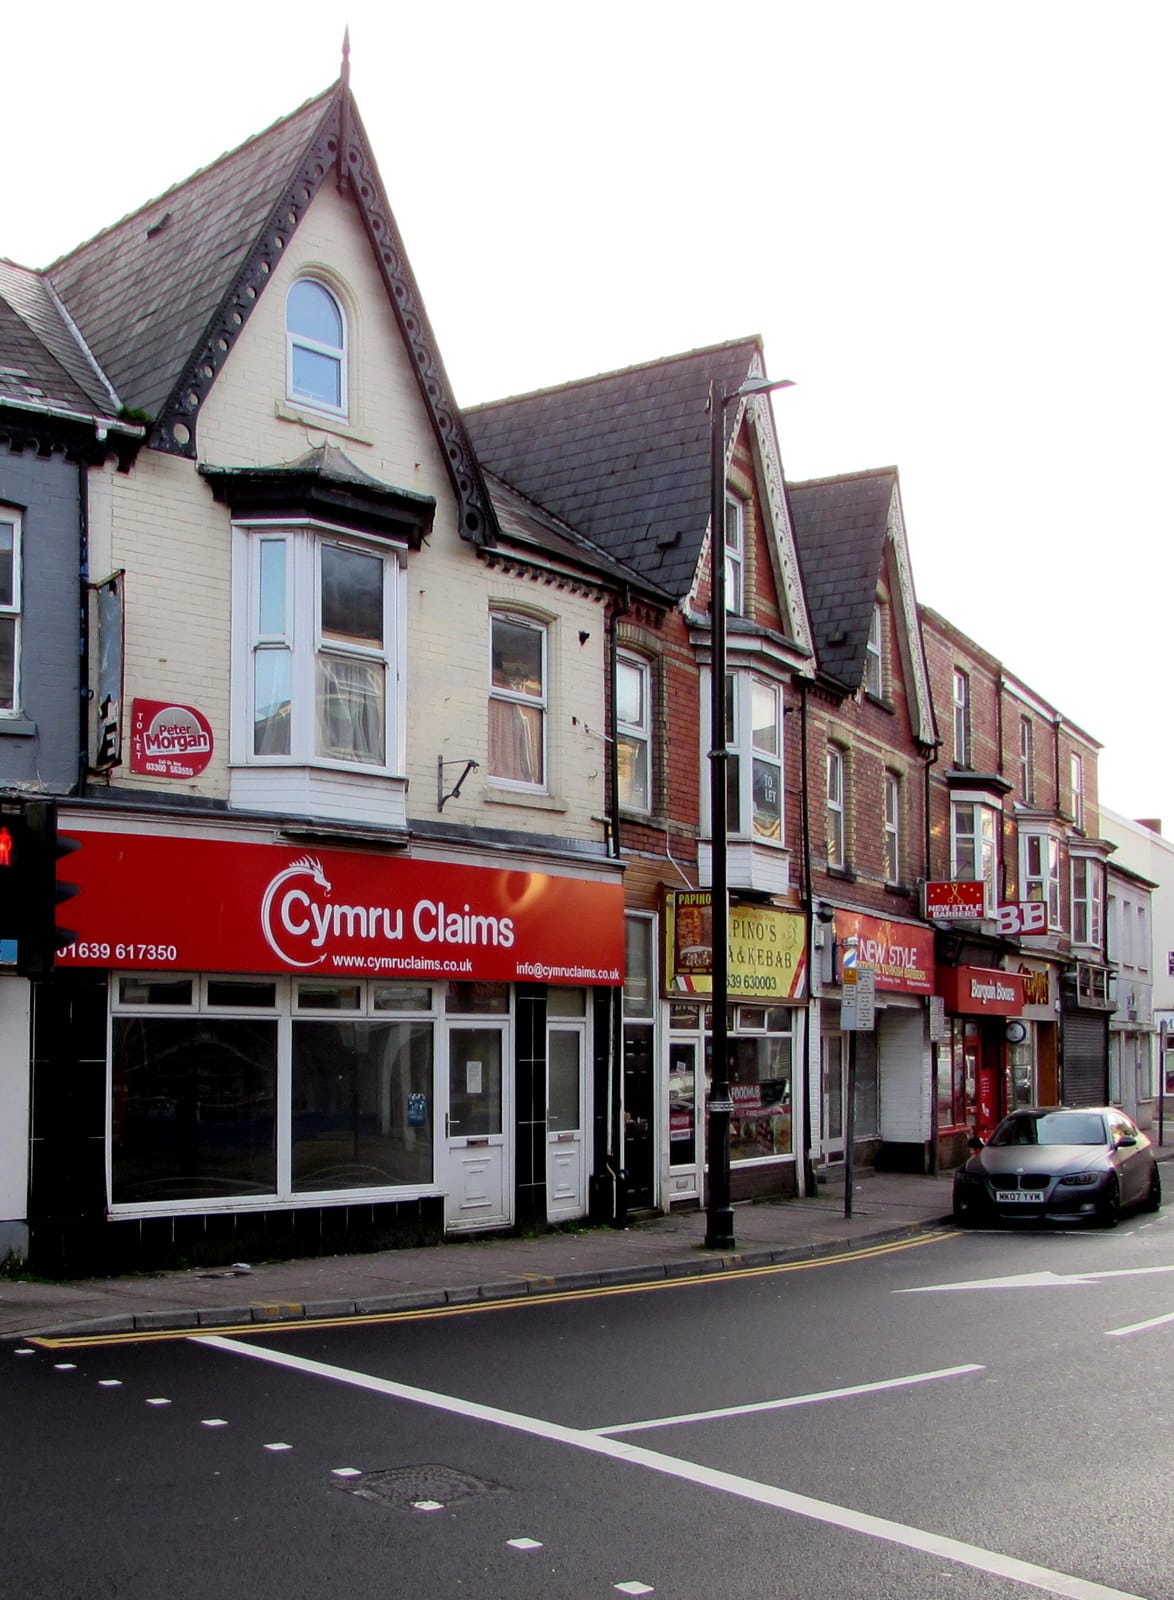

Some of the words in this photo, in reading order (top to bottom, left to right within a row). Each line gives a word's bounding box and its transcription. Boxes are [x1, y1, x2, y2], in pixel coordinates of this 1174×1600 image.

[159, 724, 191, 736] Peter
[146, 734, 208, 752] Morgan
[763, 774, 773, 788] TO
[765, 788, 777, 803] LET
[928, 904, 950, 912] NEW
[951, 903, 983, 912] STYLE
[933, 910, 978, 918] BARBERS
[281, 889, 402, 947] Cymru
[412, 899, 515, 948] Claims
[115, 943, 177, 960] 617350
[748, 947, 792, 969] KEBAB
[860, 939, 886, 963] NEW
[889, 945, 917, 969] STYLE
[332, 953, 473, 972] www.cymruclaims.co.uk
[516, 961, 620, 981] info@cymruclaims.co.uk
[743, 975, 777, 990] 630003
[971, 978, 996, 1005] Bargain
